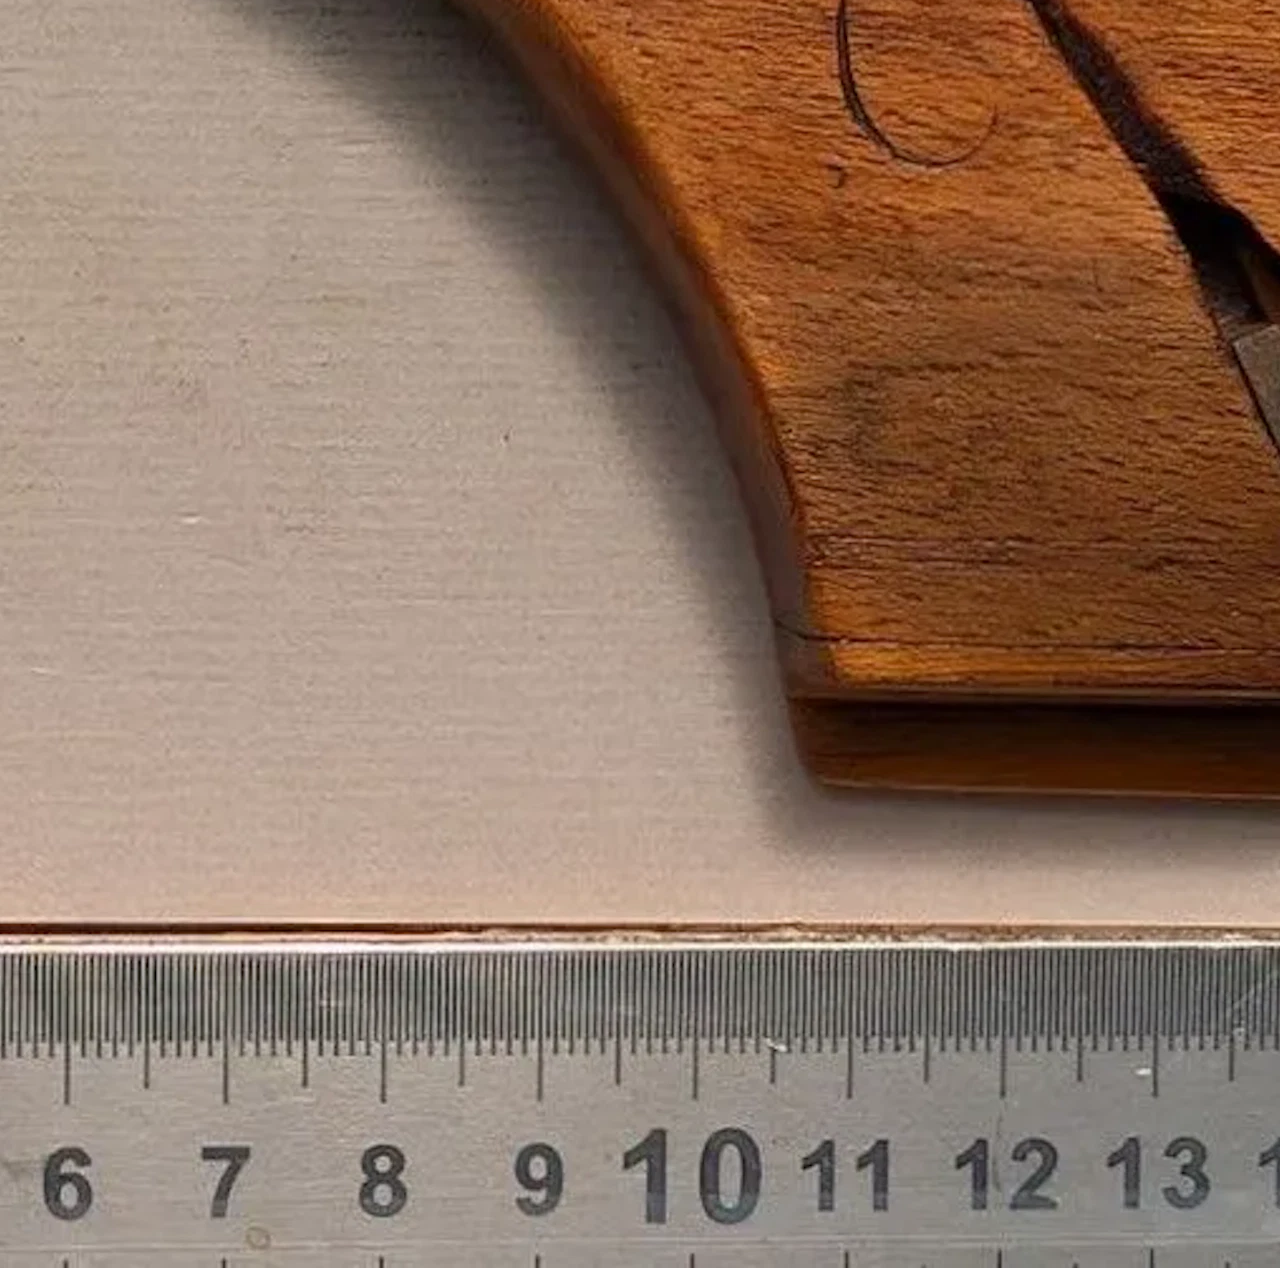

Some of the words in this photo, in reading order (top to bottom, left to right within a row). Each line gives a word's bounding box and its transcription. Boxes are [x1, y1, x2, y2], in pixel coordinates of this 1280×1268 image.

[43, 1146, 93, 1221] 6
[201, 1146, 251, 1218] 7
[358, 1144, 408, 1218] 8
[514, 1142, 564, 1217] 9
[623, 1127, 762, 1225] 10
[801, 1139, 889, 1212] 11
[955, 1138, 1059, 1211] 12
[1106, 1137, 1211, 1210] 13
